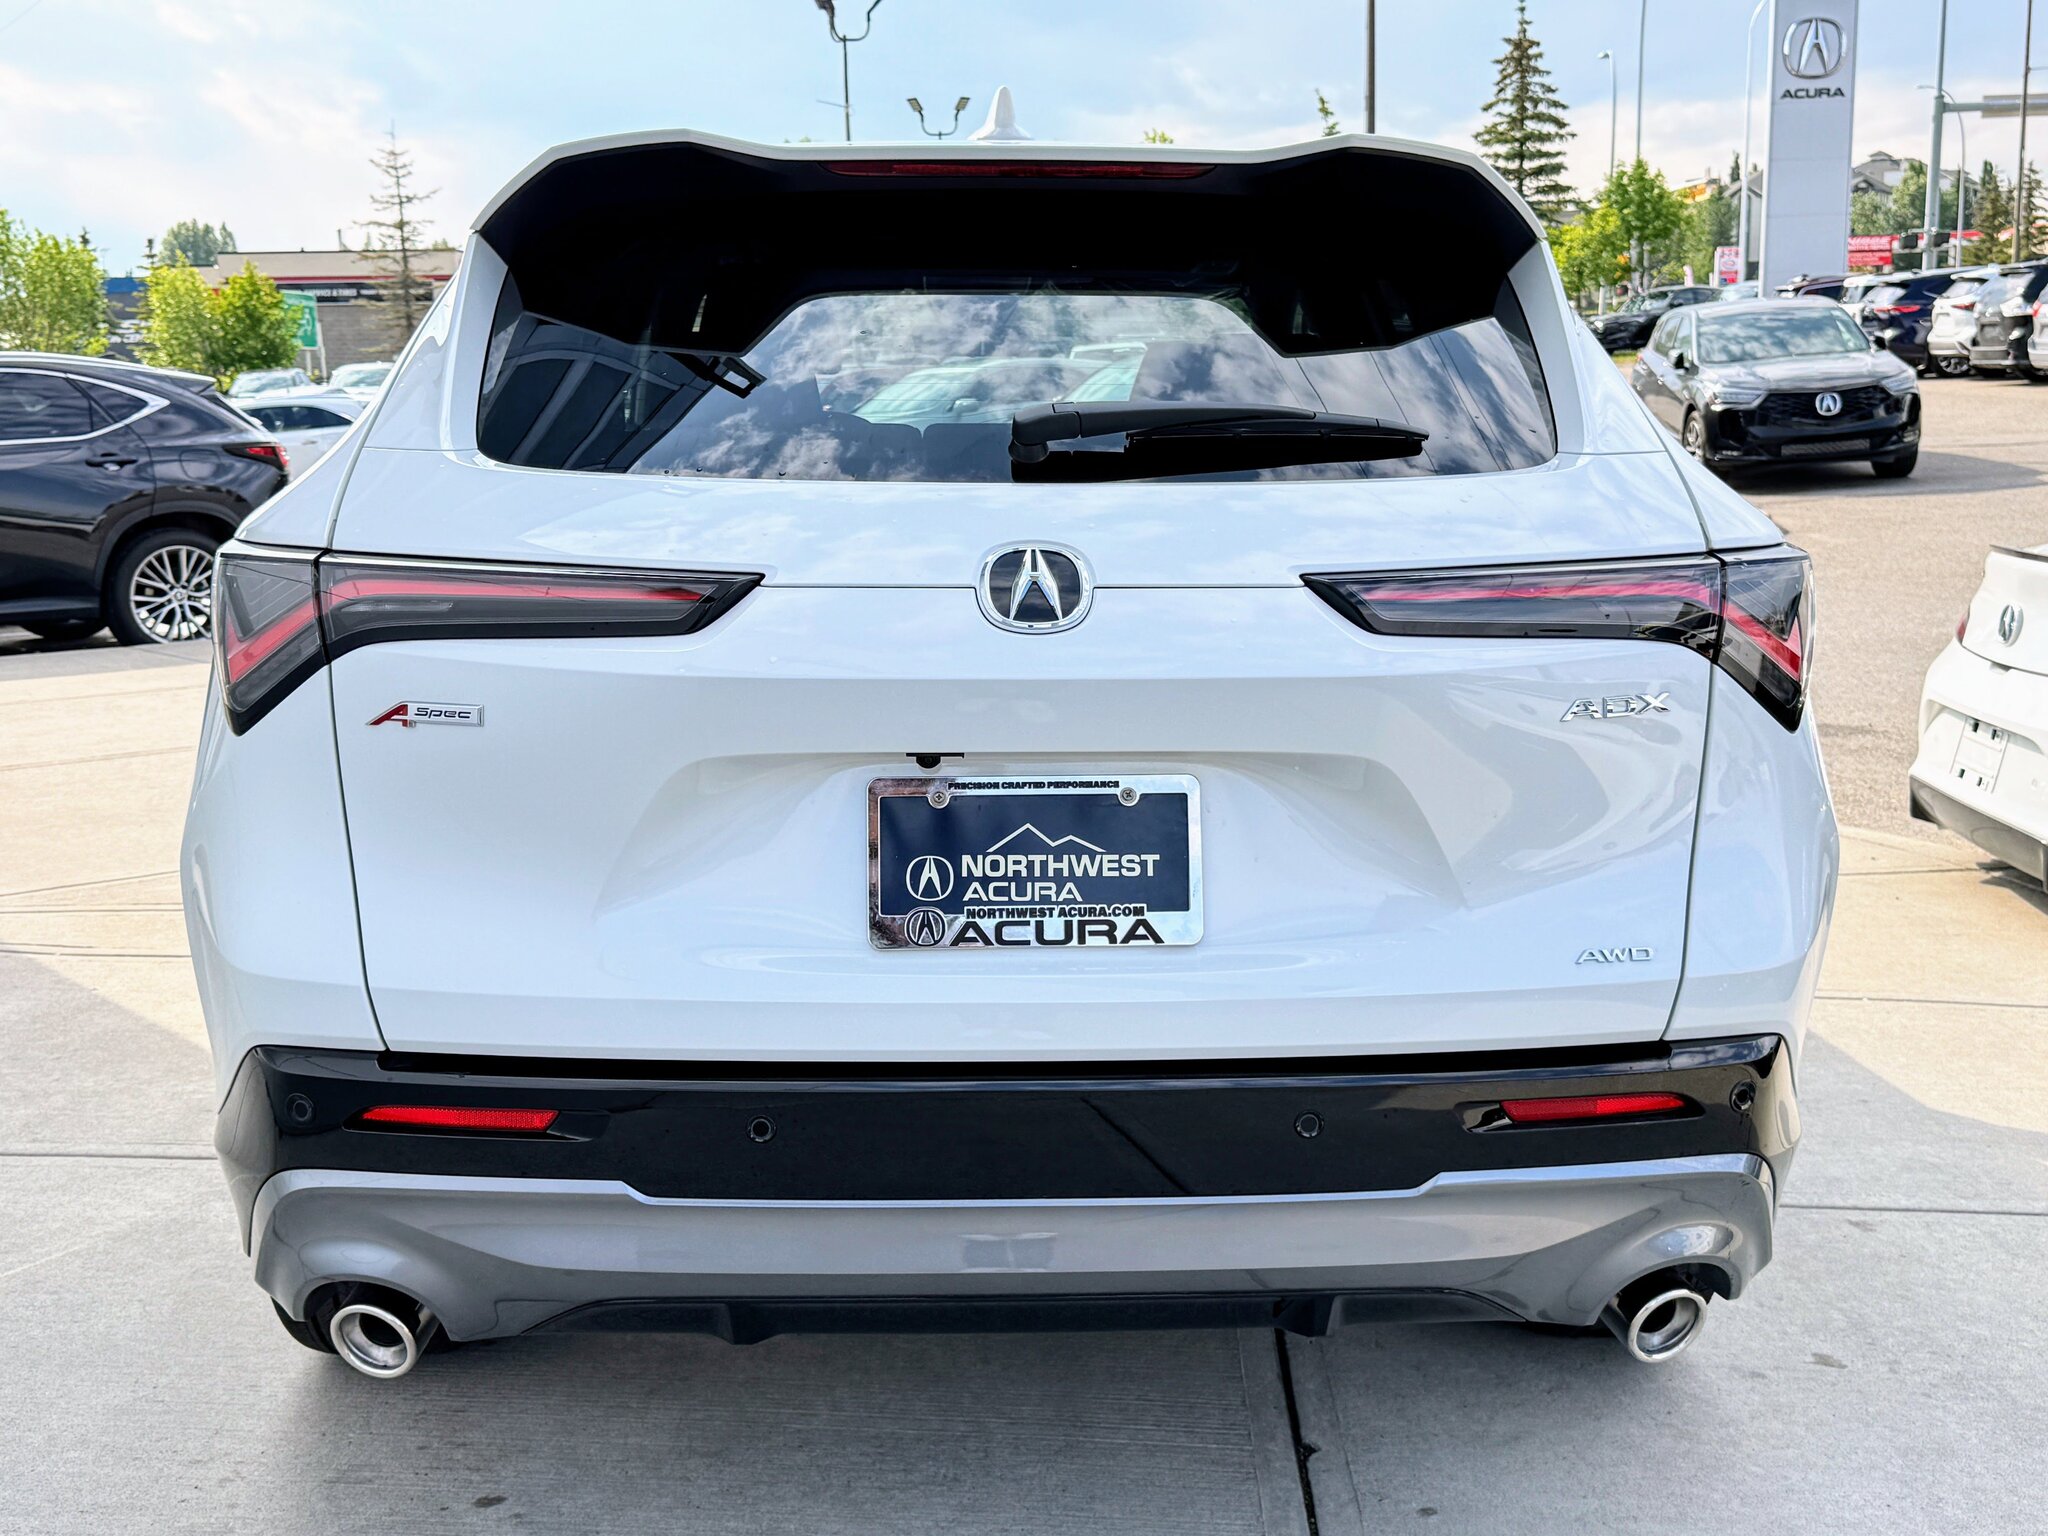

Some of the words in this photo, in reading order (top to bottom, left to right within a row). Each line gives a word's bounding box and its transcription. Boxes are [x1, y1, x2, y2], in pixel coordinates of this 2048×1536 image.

[1780, 87, 1845, 99] ACURA
[1559, 690, 1671, 722] ADX
[947, 781, 1000, 791] PRECISION
[1001, 781, 1046, 790] CRAFTED
[1047, 780, 1120, 789] PERFORMANCE
[961, 853, 1161, 878] NORTHWEST
[962, 881, 1083, 902] ACURA
[965, 906, 1056, 919] NORTHWEST
[1057, 905, 1145, 918] ACURA.COM
[950, 918, 1165, 946] ACURA
[1574, 947, 1654, 965] AWD
